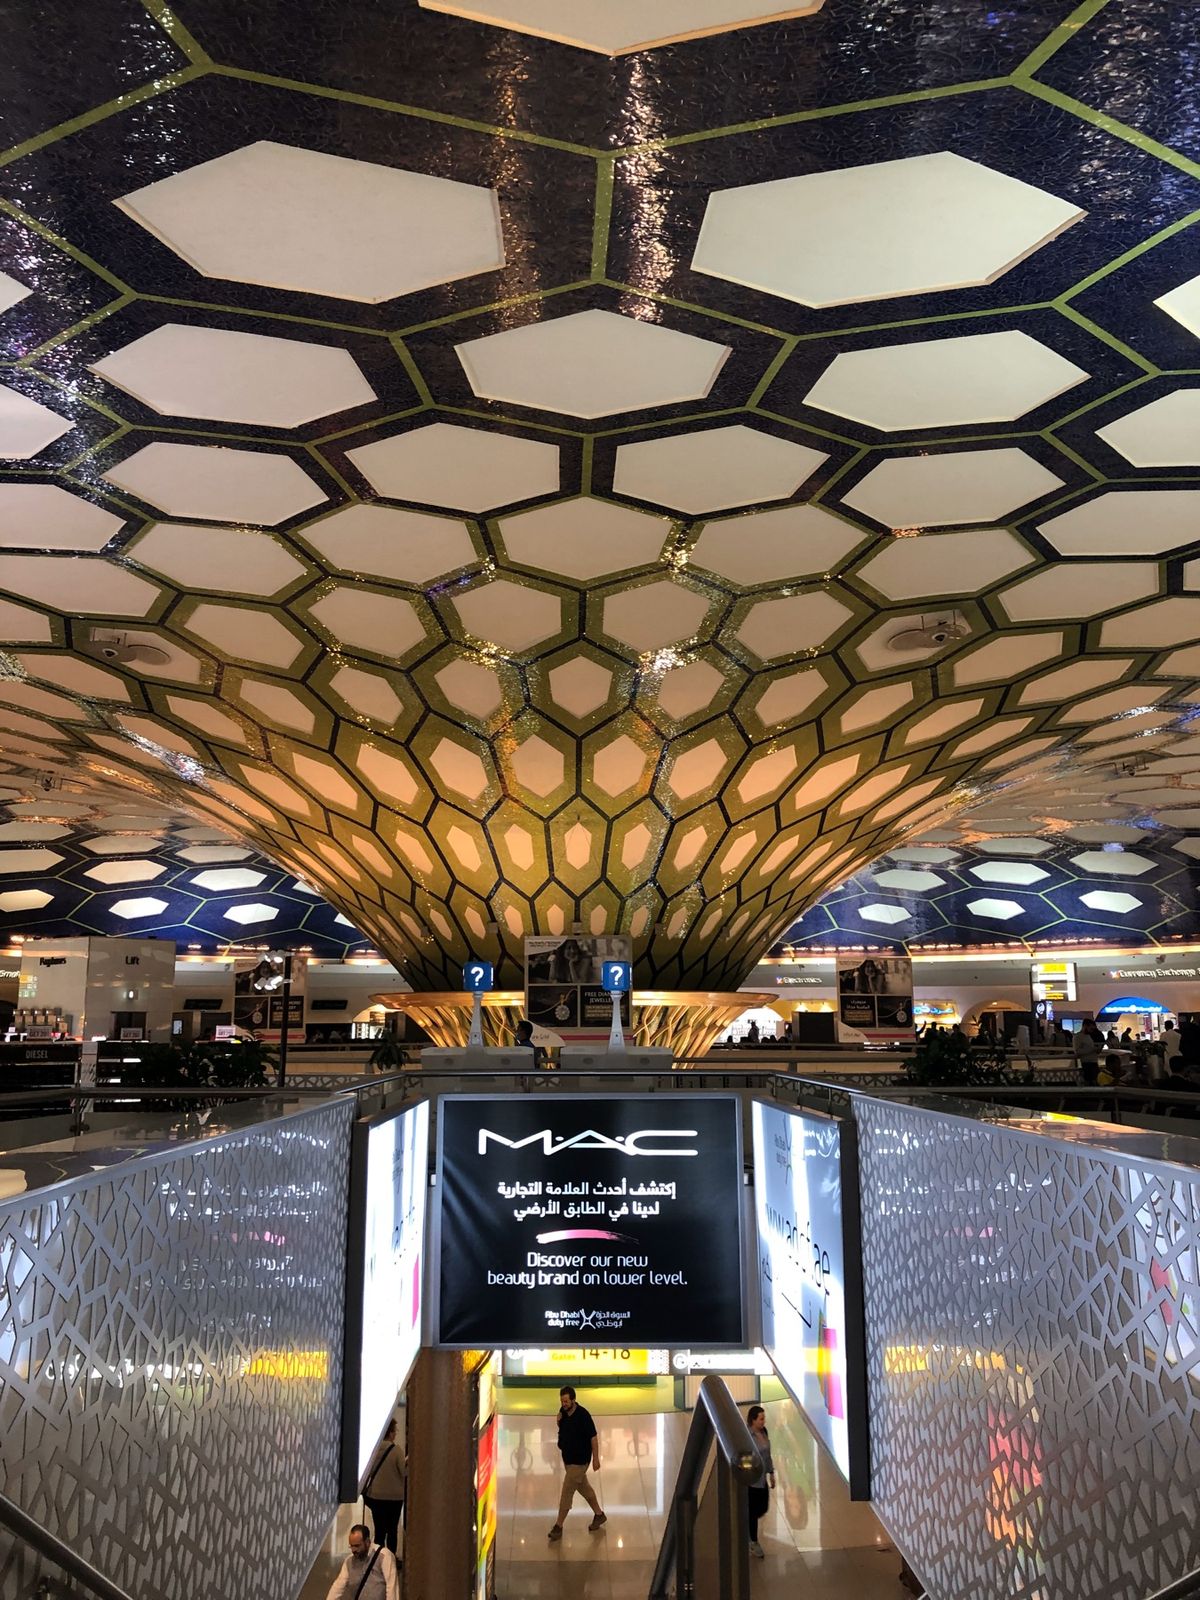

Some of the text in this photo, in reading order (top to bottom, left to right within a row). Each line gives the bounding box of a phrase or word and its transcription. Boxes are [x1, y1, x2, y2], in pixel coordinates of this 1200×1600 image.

[1119, 970, 1156, 978] Currency
[1156, 968, 1196, 977] Exchange
[26, 1050, 48, 1058] DIESEL
[497, 1181, 543, 1198] التجارية
[545, 1182, 589, 1196] العلامة
[592, 1177, 627, 1196] أحدث
[513, 1199, 660, 1221] لدينا في الطابق الأرضي
[527, 1252, 649, 1268] Discover our new
[487, 1270, 688, 1289] beauty brand on lower level.
[544, 1310, 580, 1319] Abu Dhabi
[547, 1319, 580, 1328] duty free
